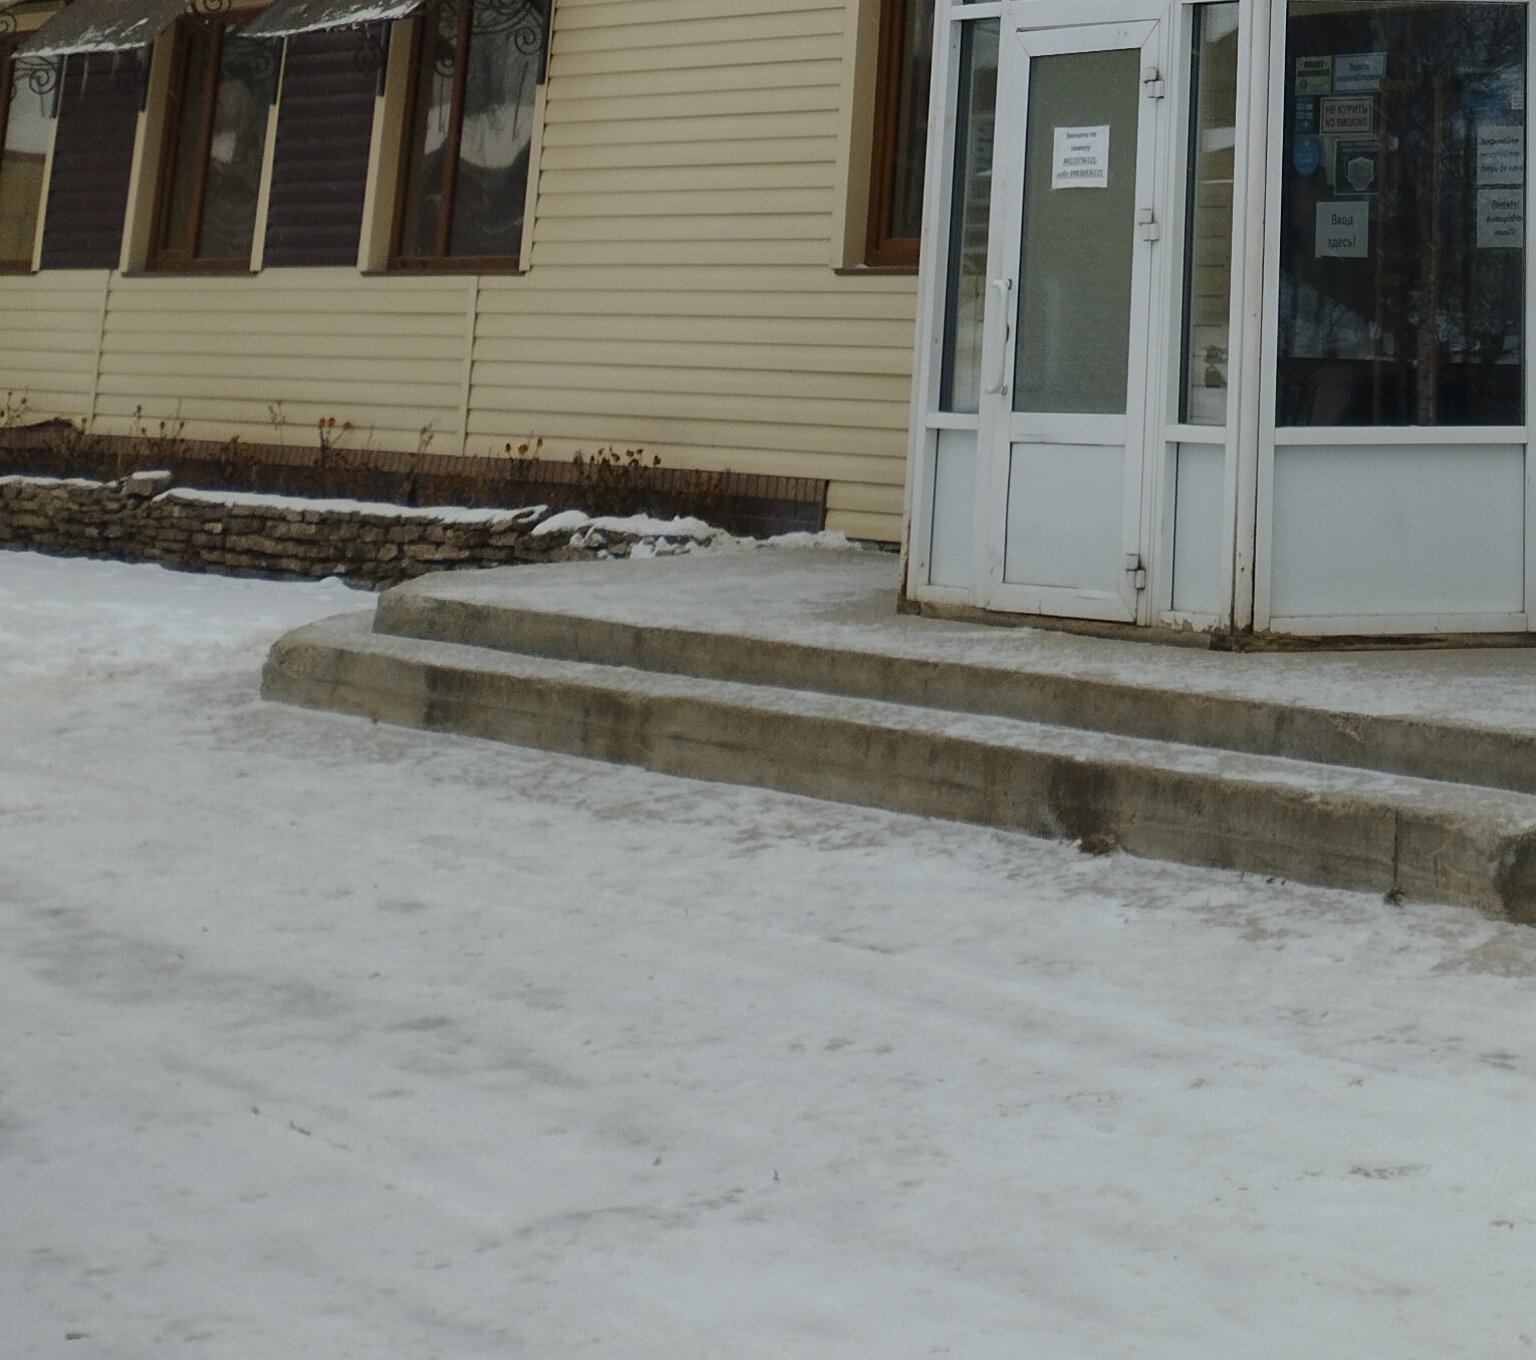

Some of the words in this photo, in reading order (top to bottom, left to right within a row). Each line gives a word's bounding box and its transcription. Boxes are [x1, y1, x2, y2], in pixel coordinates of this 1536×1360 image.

[1325, 105, 1336, 114] НЕ
[1338, 104, 1368, 114] КУРИТЬ
[1325, 118, 1335, 128] NO
[1336, 118, 1368, 128] SMOKING
[1331, 213, 1354, 227] Вход
[1327, 236, 1356, 249] здесь!
